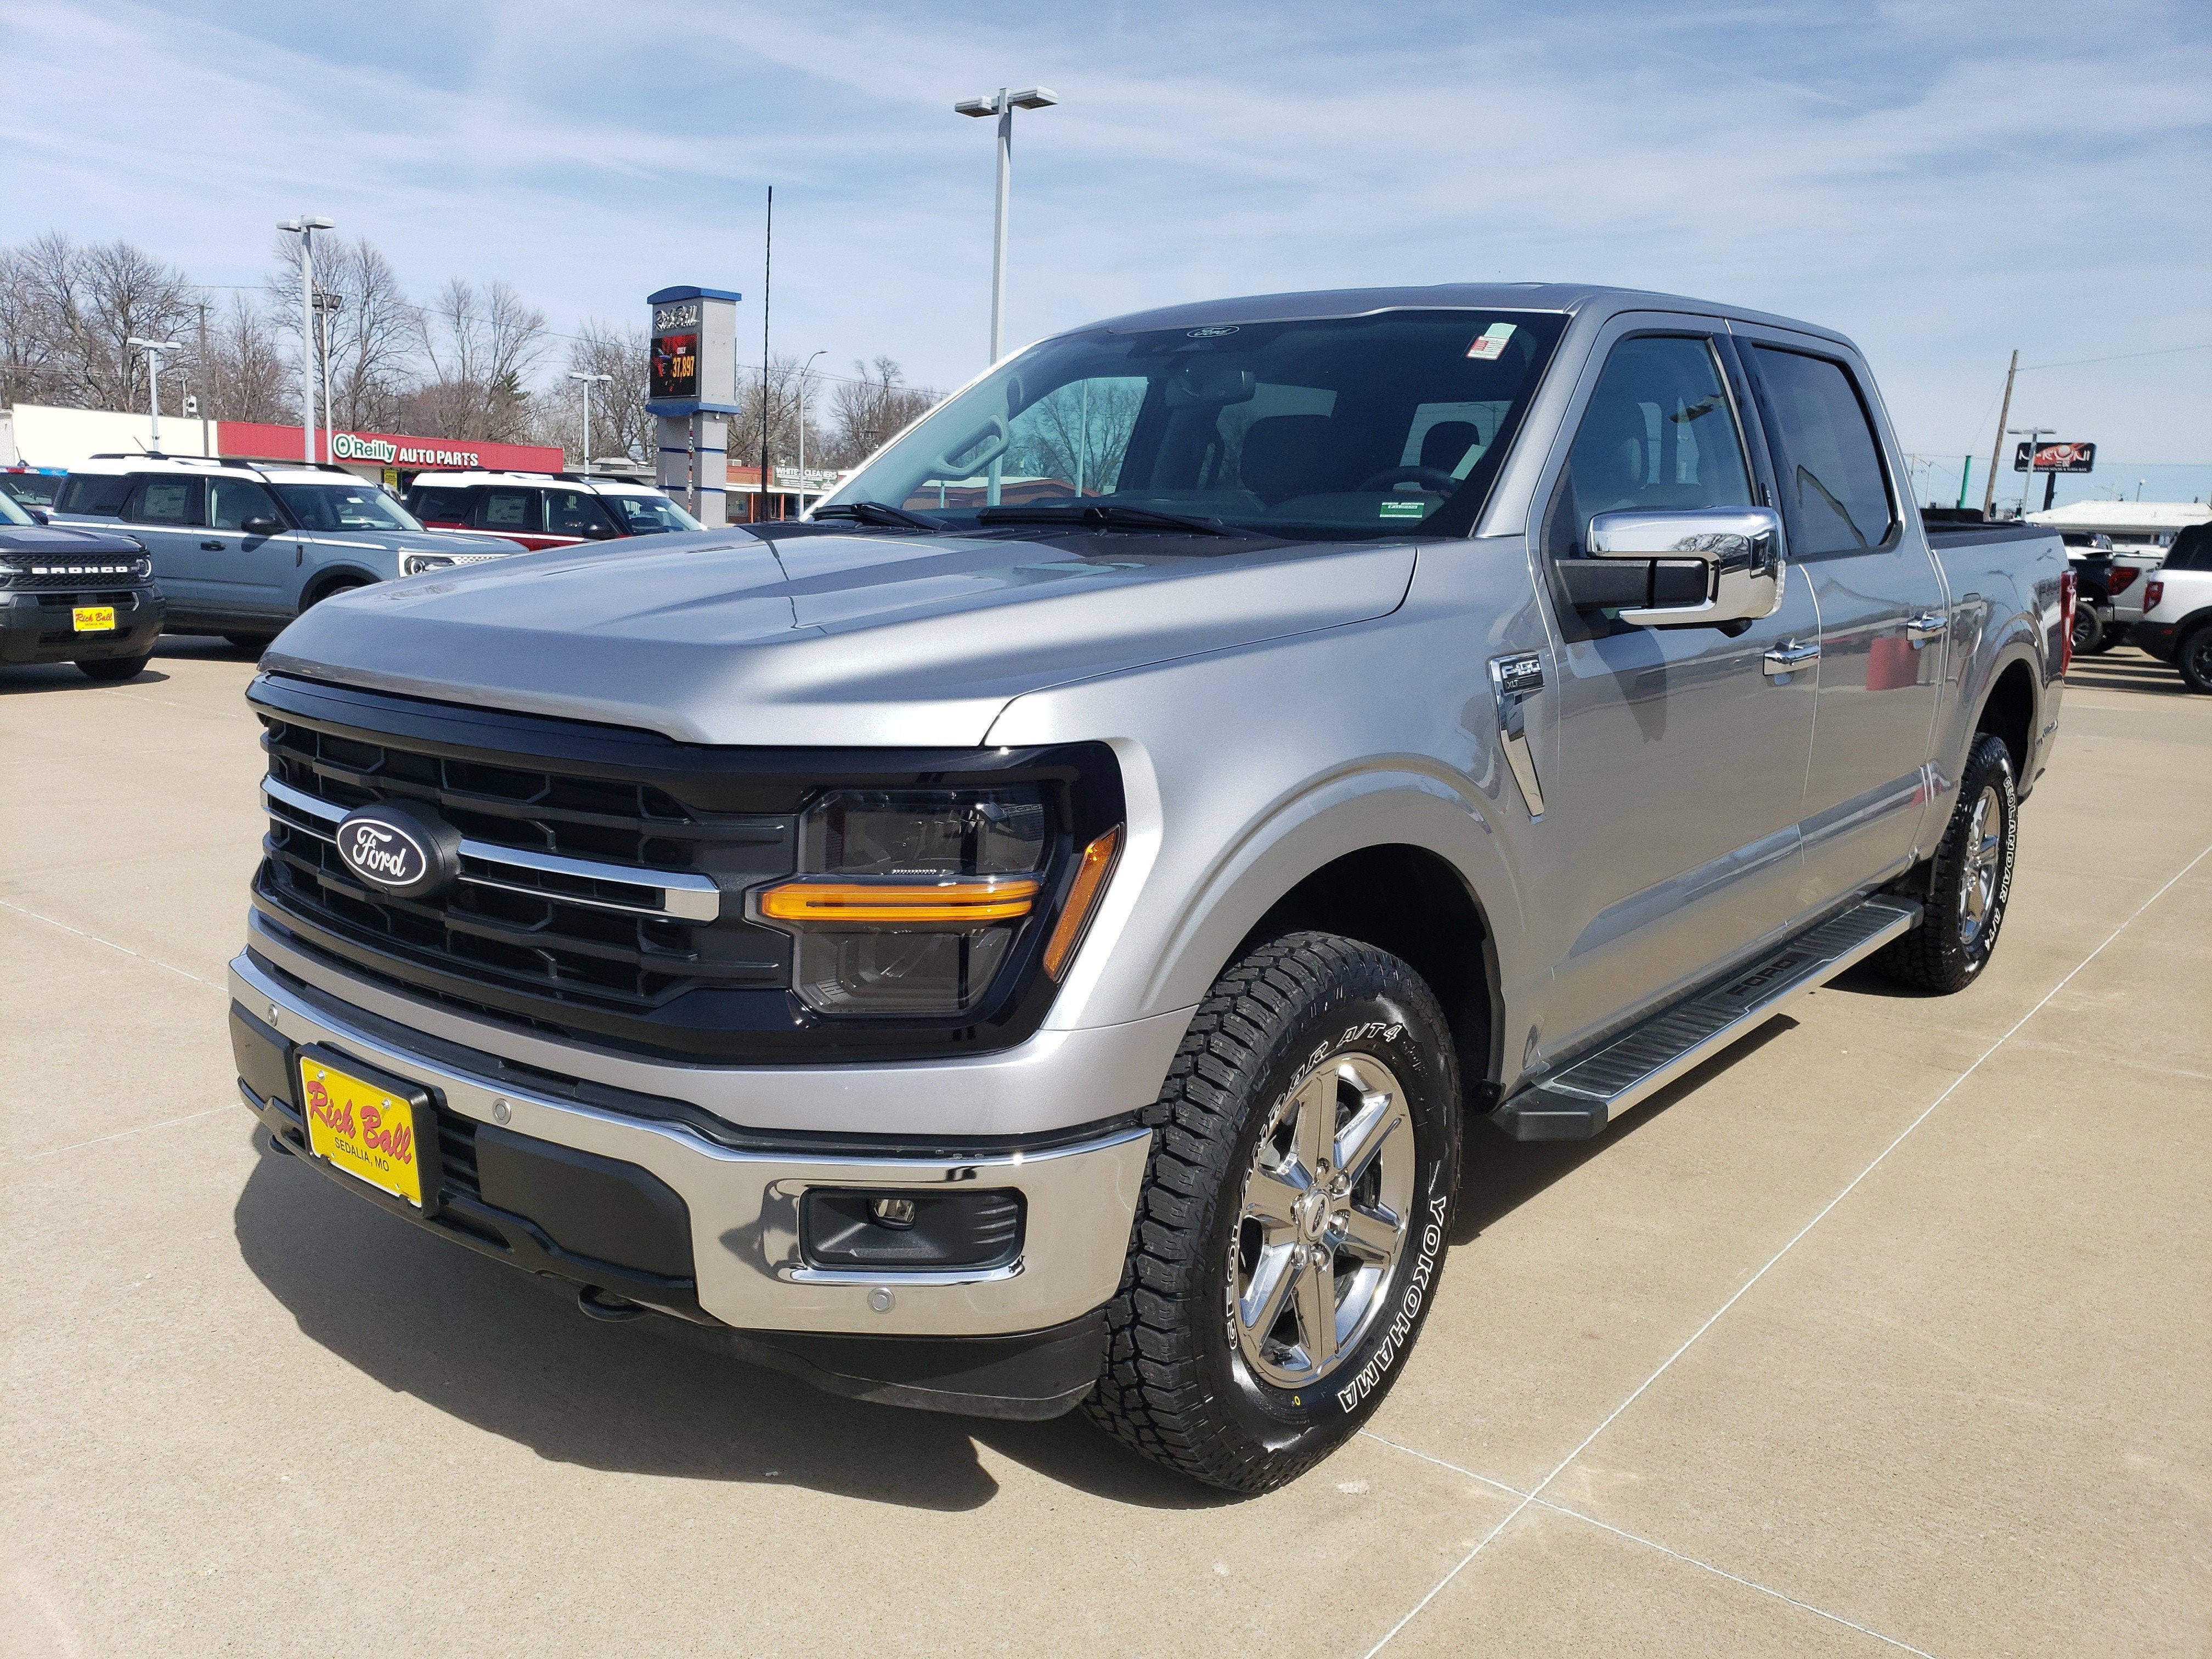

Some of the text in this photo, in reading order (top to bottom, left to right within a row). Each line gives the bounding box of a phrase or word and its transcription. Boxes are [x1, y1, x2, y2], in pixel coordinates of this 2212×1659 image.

[334, 435, 478, 466] O'Reilly AUTO PARTS
[804, 469, 837, 479] CLEANERS
[32, 566, 128, 574] BRONCO
[1502, 659, 1541, 679] F-150
[1506, 679, 1519, 689] XLT
[353, 826, 407, 877] Ford
[1999, 775, 2017, 904] GEOLANDAR
[1726, 960, 1797, 996] FORD
[1336, 1022, 1403, 1049] A/T4
[307, 1080, 412, 1165] Rick Ball
[335, 1137, 390, 1172] SEDALIA, MO
[1338, 1196, 1447, 1413] YOKOHAMA
